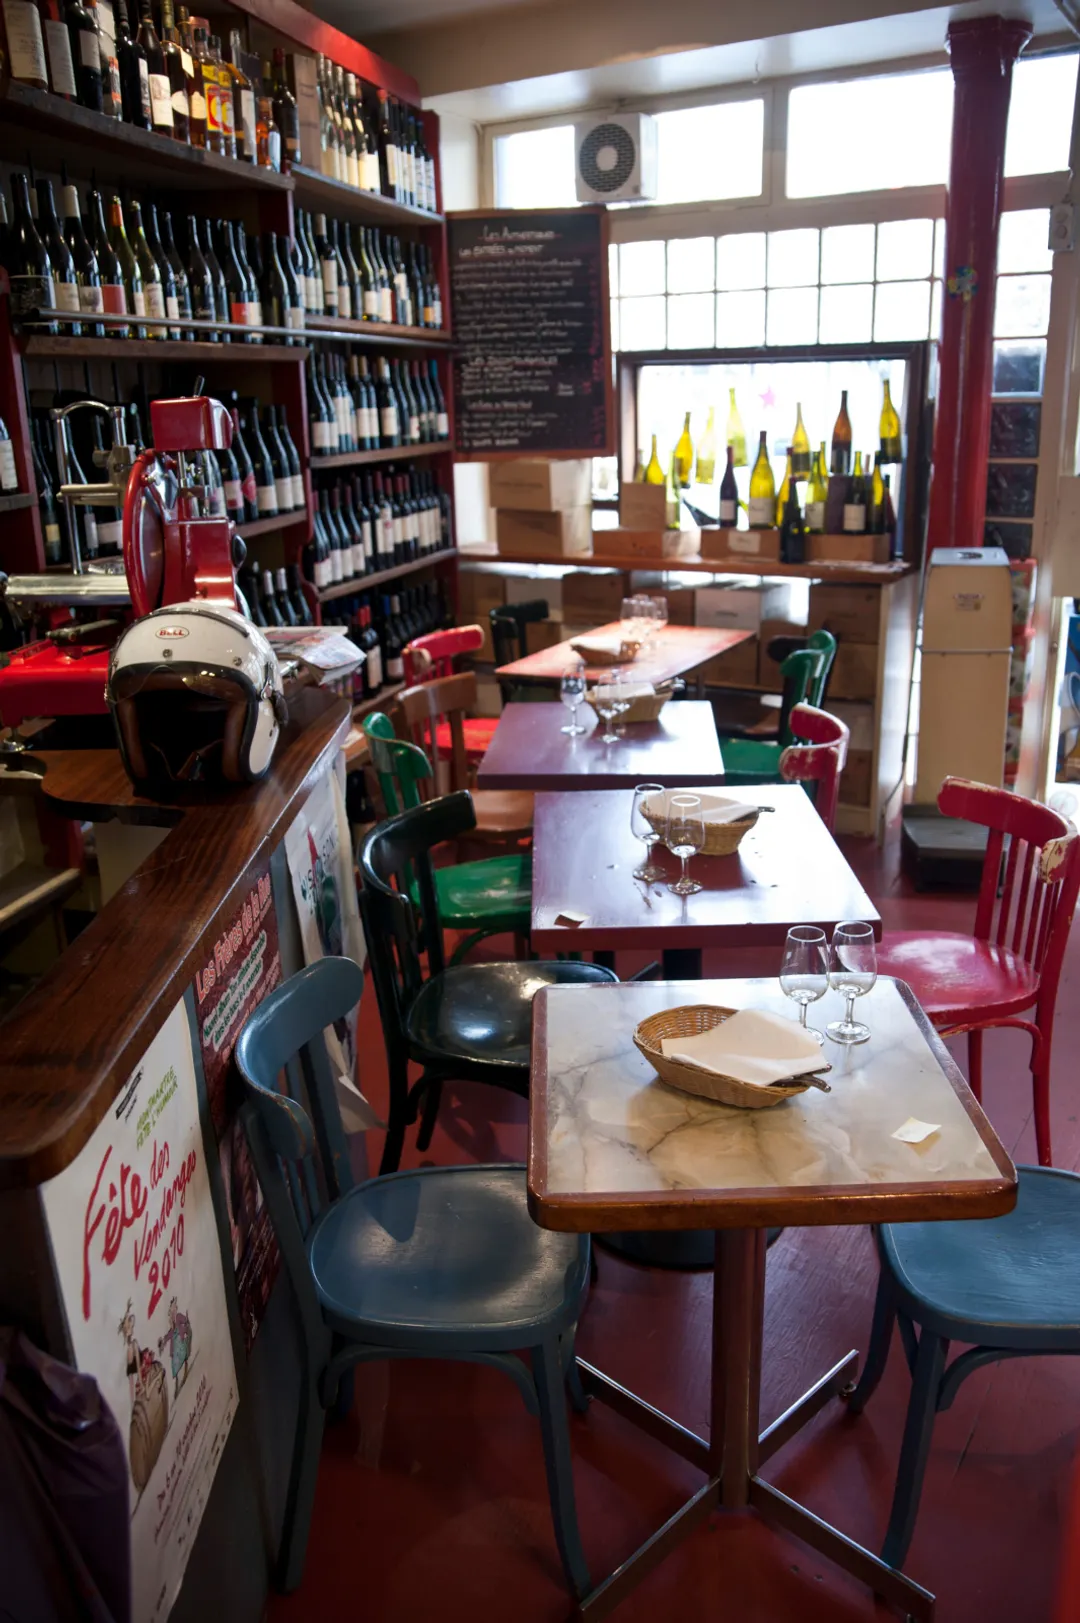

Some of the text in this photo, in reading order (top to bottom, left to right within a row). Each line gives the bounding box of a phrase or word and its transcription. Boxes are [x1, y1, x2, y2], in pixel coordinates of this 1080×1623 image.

[196, 960, 216, 1004] Les
[214, 920, 243, 978] Frères
[241, 902, 253, 936] de
[82, 1144, 148, 1321] Fête
[151, 1139, 170, 1190] des
[133, 1149, 197, 1281] Vendanges
[148, 1213, 185, 1320] 2010
